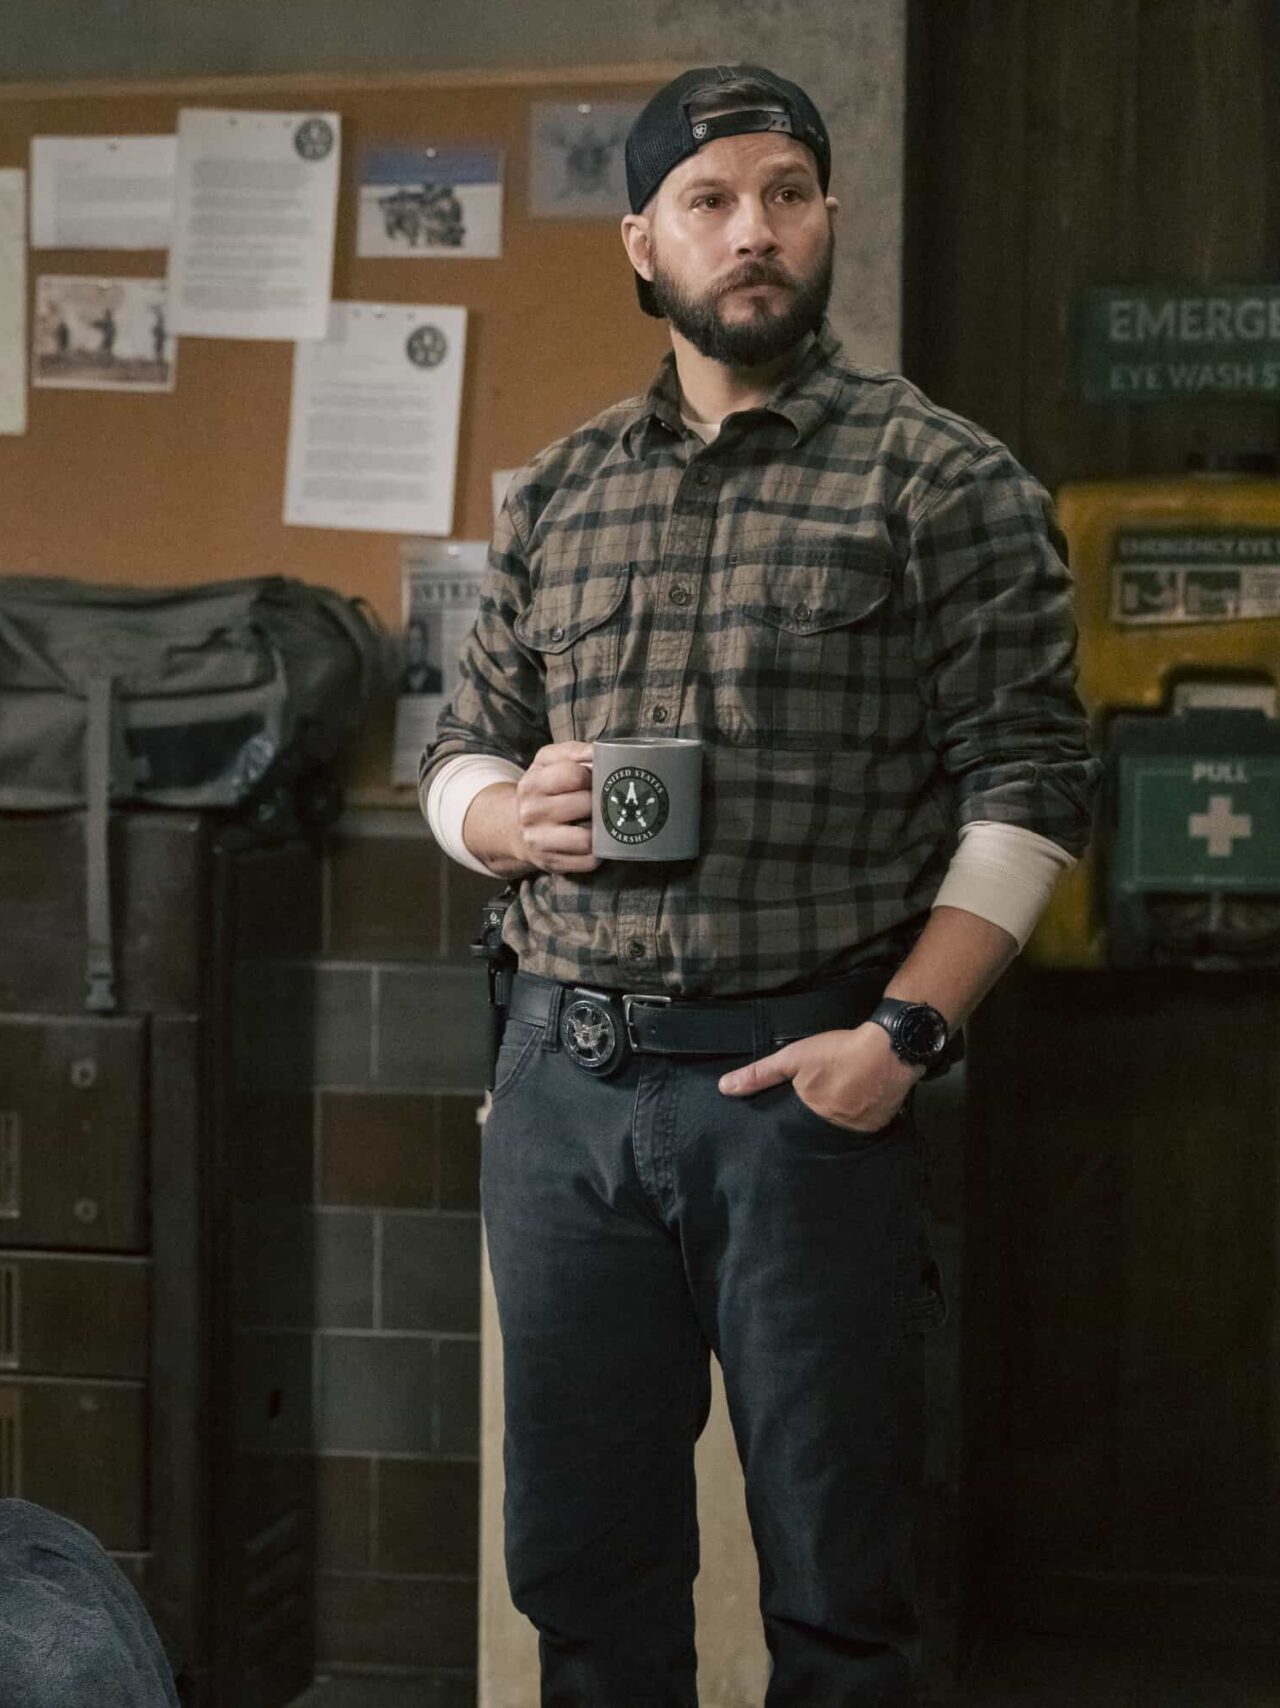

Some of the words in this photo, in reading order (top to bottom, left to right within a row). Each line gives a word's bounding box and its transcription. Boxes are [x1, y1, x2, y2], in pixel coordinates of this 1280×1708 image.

[1110, 363, 1162, 390] EYE
[1169, 362, 1255, 391] WASH
[604, 769, 631, 792] UNITED
[635, 770, 664, 793] STATES
[1192, 761, 1246, 783] PULL
[611, 829, 654, 843] MARSHAL
